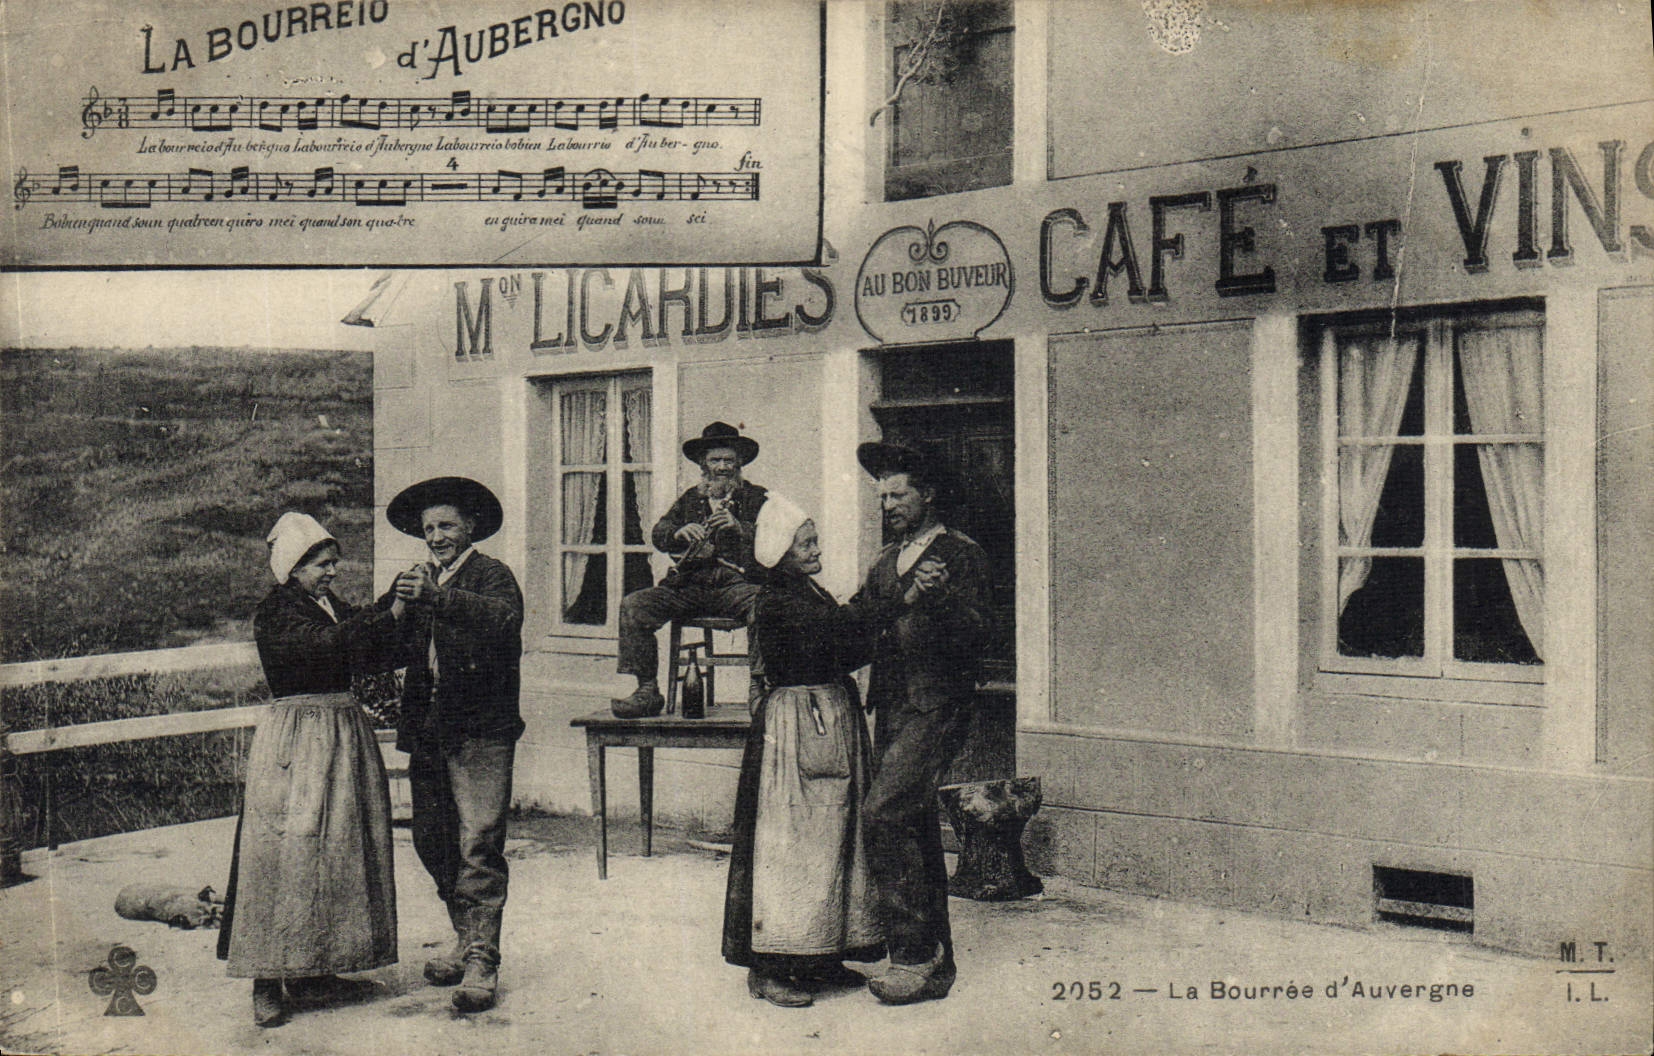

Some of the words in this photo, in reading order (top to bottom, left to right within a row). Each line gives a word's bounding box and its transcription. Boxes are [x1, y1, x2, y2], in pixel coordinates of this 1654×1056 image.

[1321, 219, 1401, 282] ET
[862, 273, 887, 296] AU
[892, 270, 931, 294] BON
[937, 262, 1009, 291] BUVEUR
[906, 304, 952, 324] 1899
